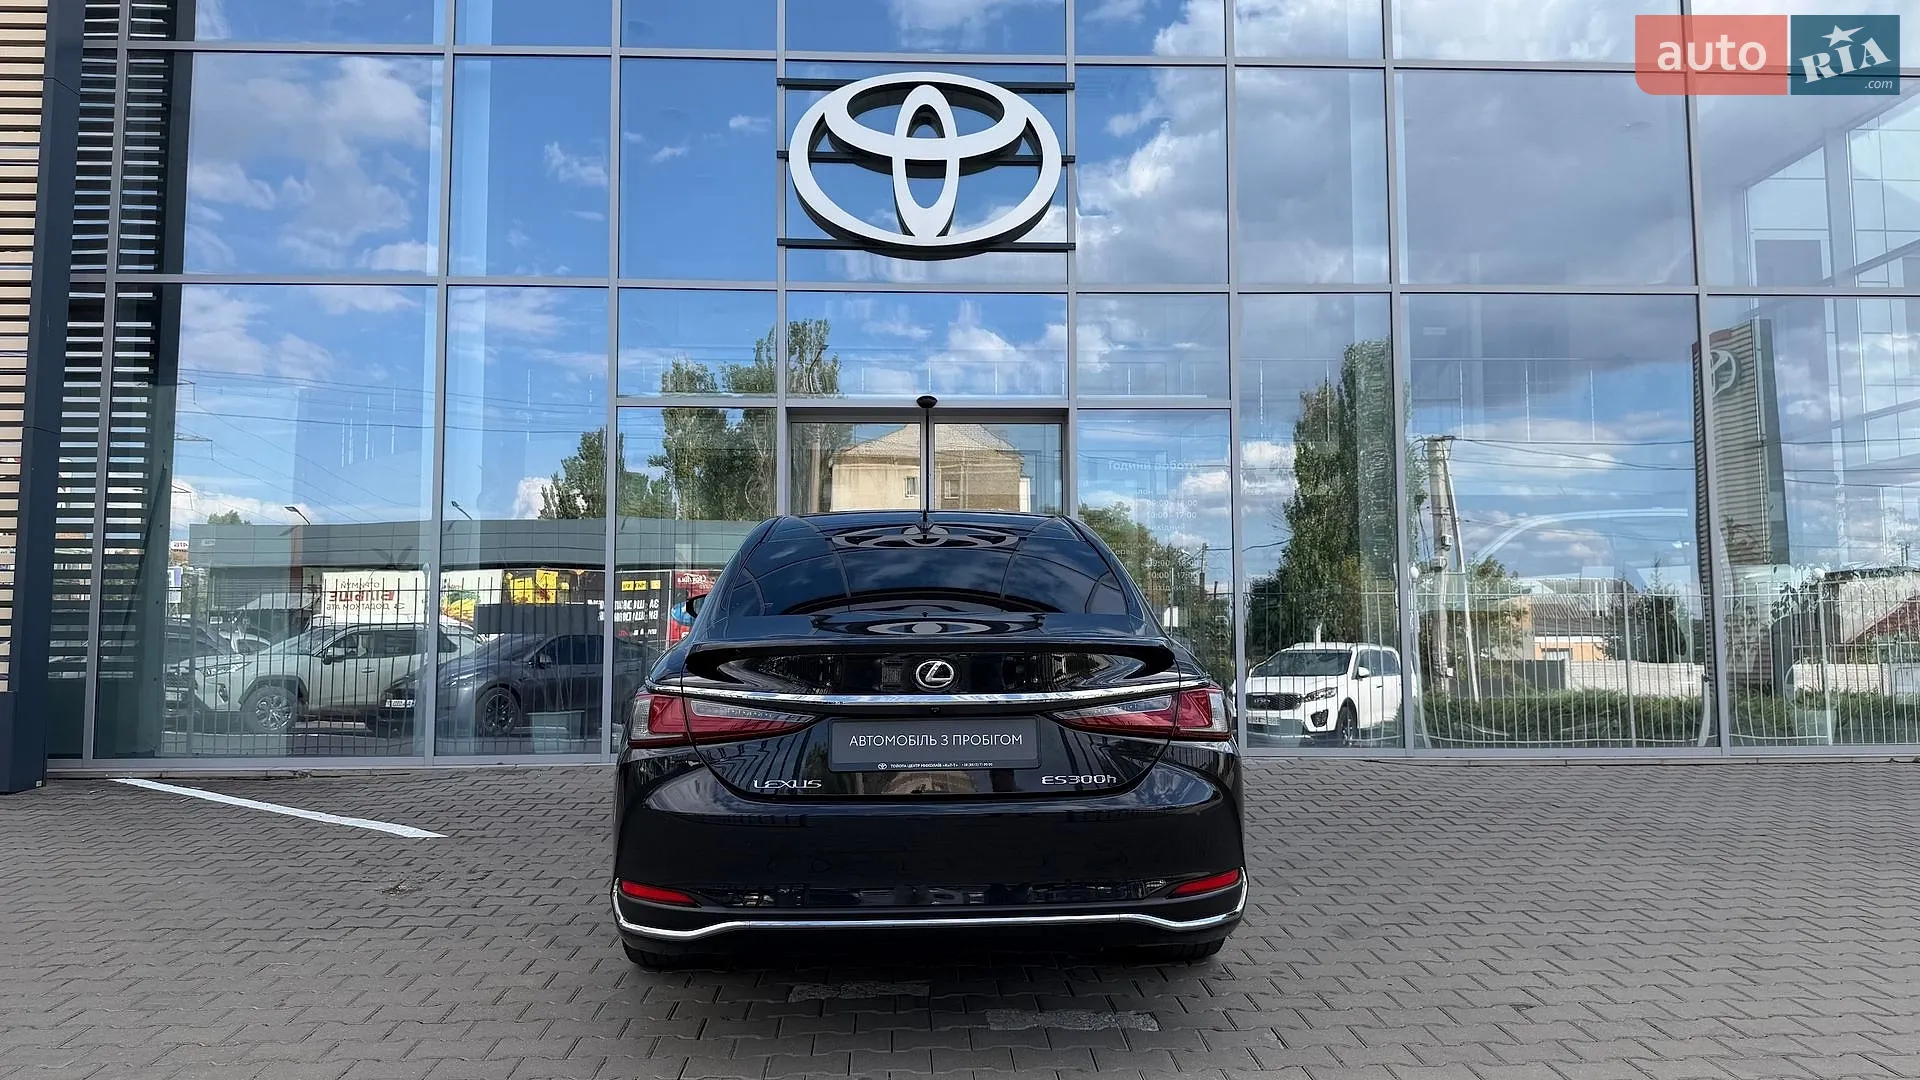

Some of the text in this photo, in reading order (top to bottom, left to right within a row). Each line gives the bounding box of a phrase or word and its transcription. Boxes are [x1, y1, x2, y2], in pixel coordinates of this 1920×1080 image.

[849, 734, 1023, 747] АВТОМОБІЛЬ З ПРОБІГОМ
[753, 779, 822, 789] LEXUS
[1041, 774, 1117, 785] ES300h
